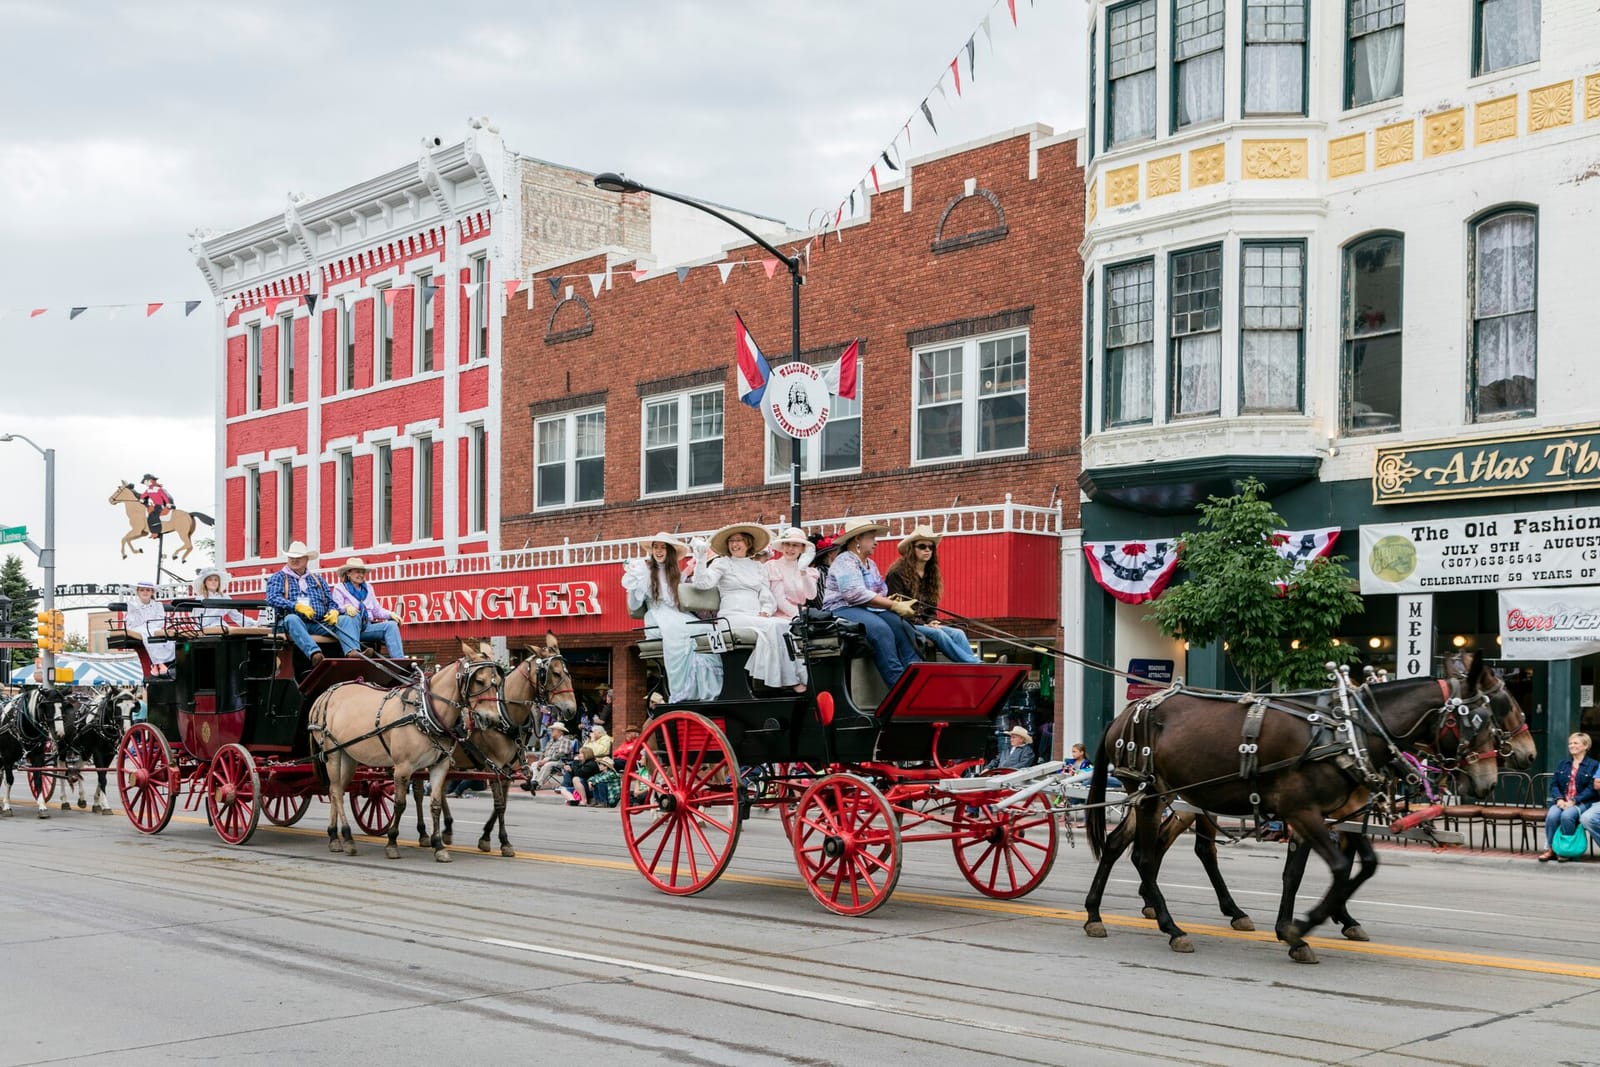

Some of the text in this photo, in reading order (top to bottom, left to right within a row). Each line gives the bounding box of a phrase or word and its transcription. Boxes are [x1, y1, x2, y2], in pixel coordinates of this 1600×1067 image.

[779, 363, 819, 381] WELCOME TO
[1424, 440, 1600, 485] Atlas Th
[1412, 515, 1600, 542] The Old Fashion
[1442, 544, 1479, 556] JULY
[1490, 541, 1520, 553] 9TH
[1582, 549, 1600, 562] (3
[1420, 568, 1596, 586] CELEBRATING 59 YEARS OF
[38, 585, 120, 597] CYENNE DEPO
[376, 581, 602, 625] WRANGLER
[1507, 609, 1554, 631] Coors
[711, 634, 723, 649] 24
[1407, 601, 1423, 675] MELO
